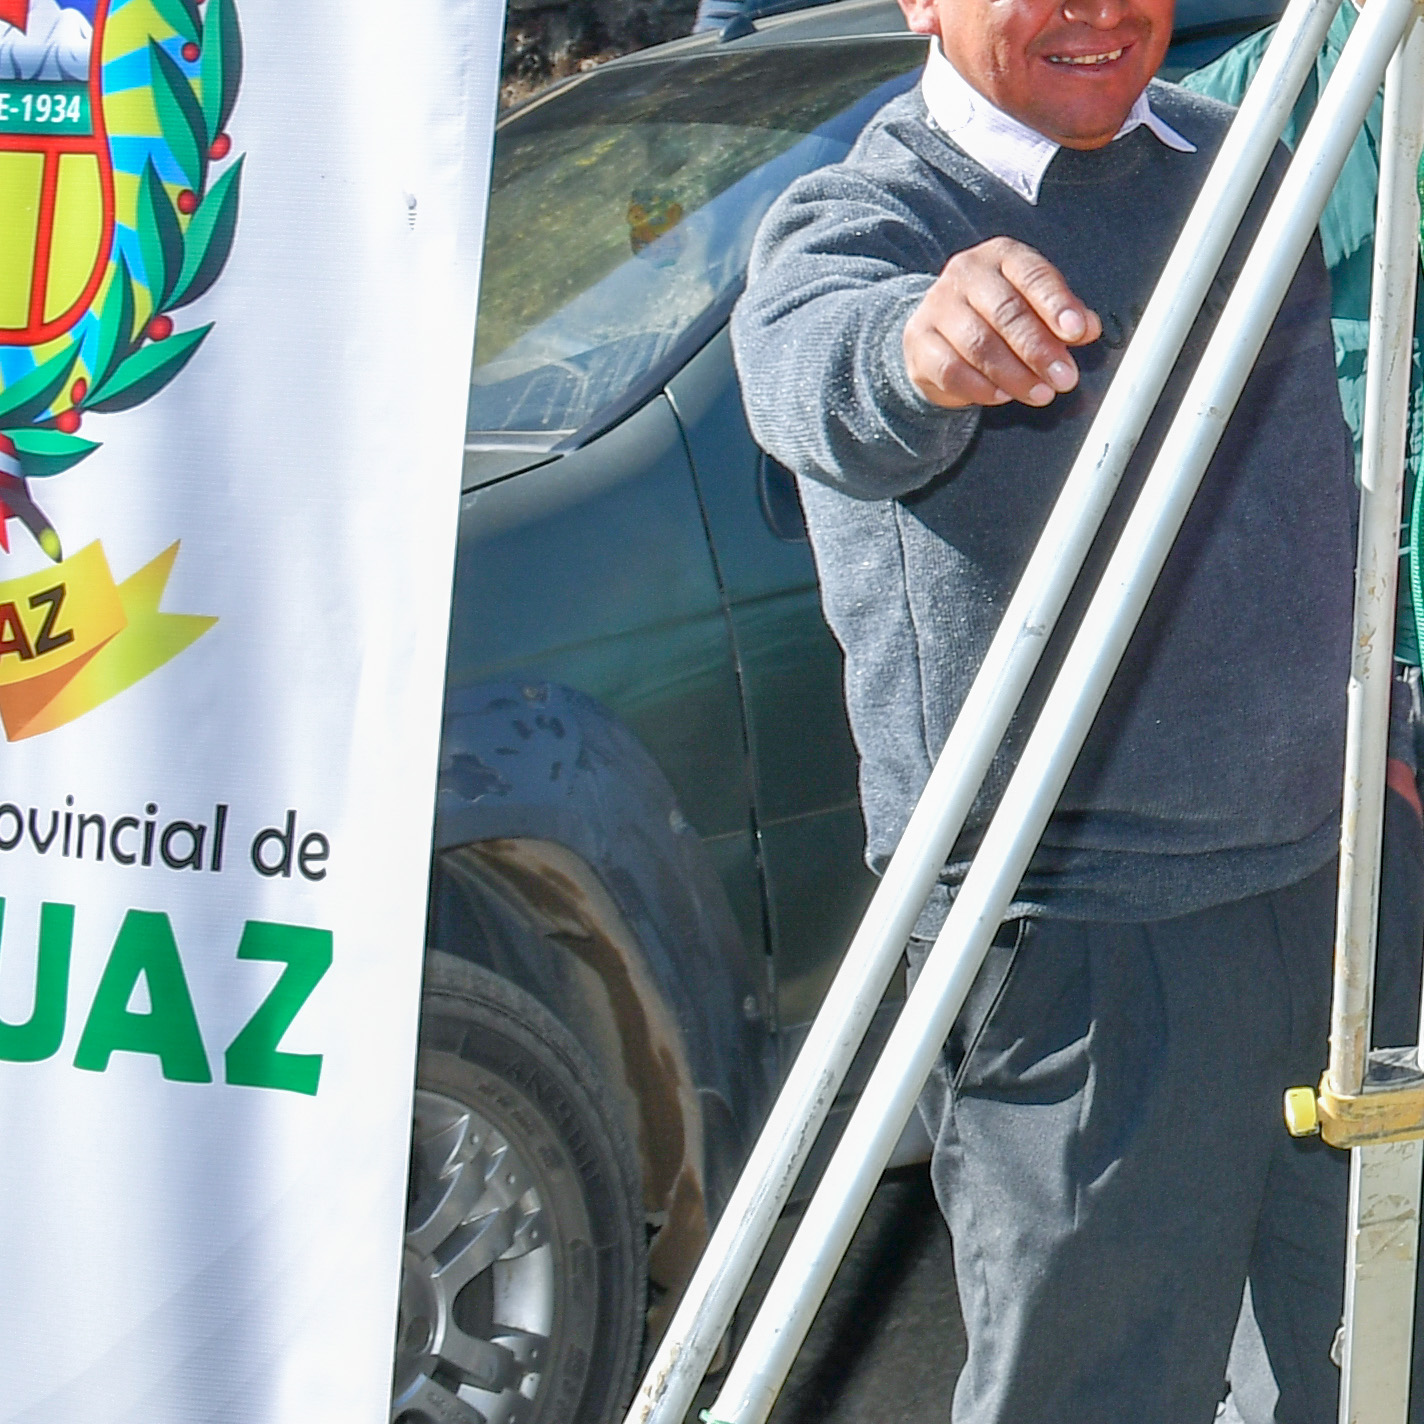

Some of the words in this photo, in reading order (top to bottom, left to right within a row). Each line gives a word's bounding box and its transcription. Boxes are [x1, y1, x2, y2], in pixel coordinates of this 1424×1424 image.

[0, 582, 75, 661] AZ
[0, 794, 229, 872] ovincial
[250, 809, 331, 882] de
[0, 896, 333, 1096] UAZ
